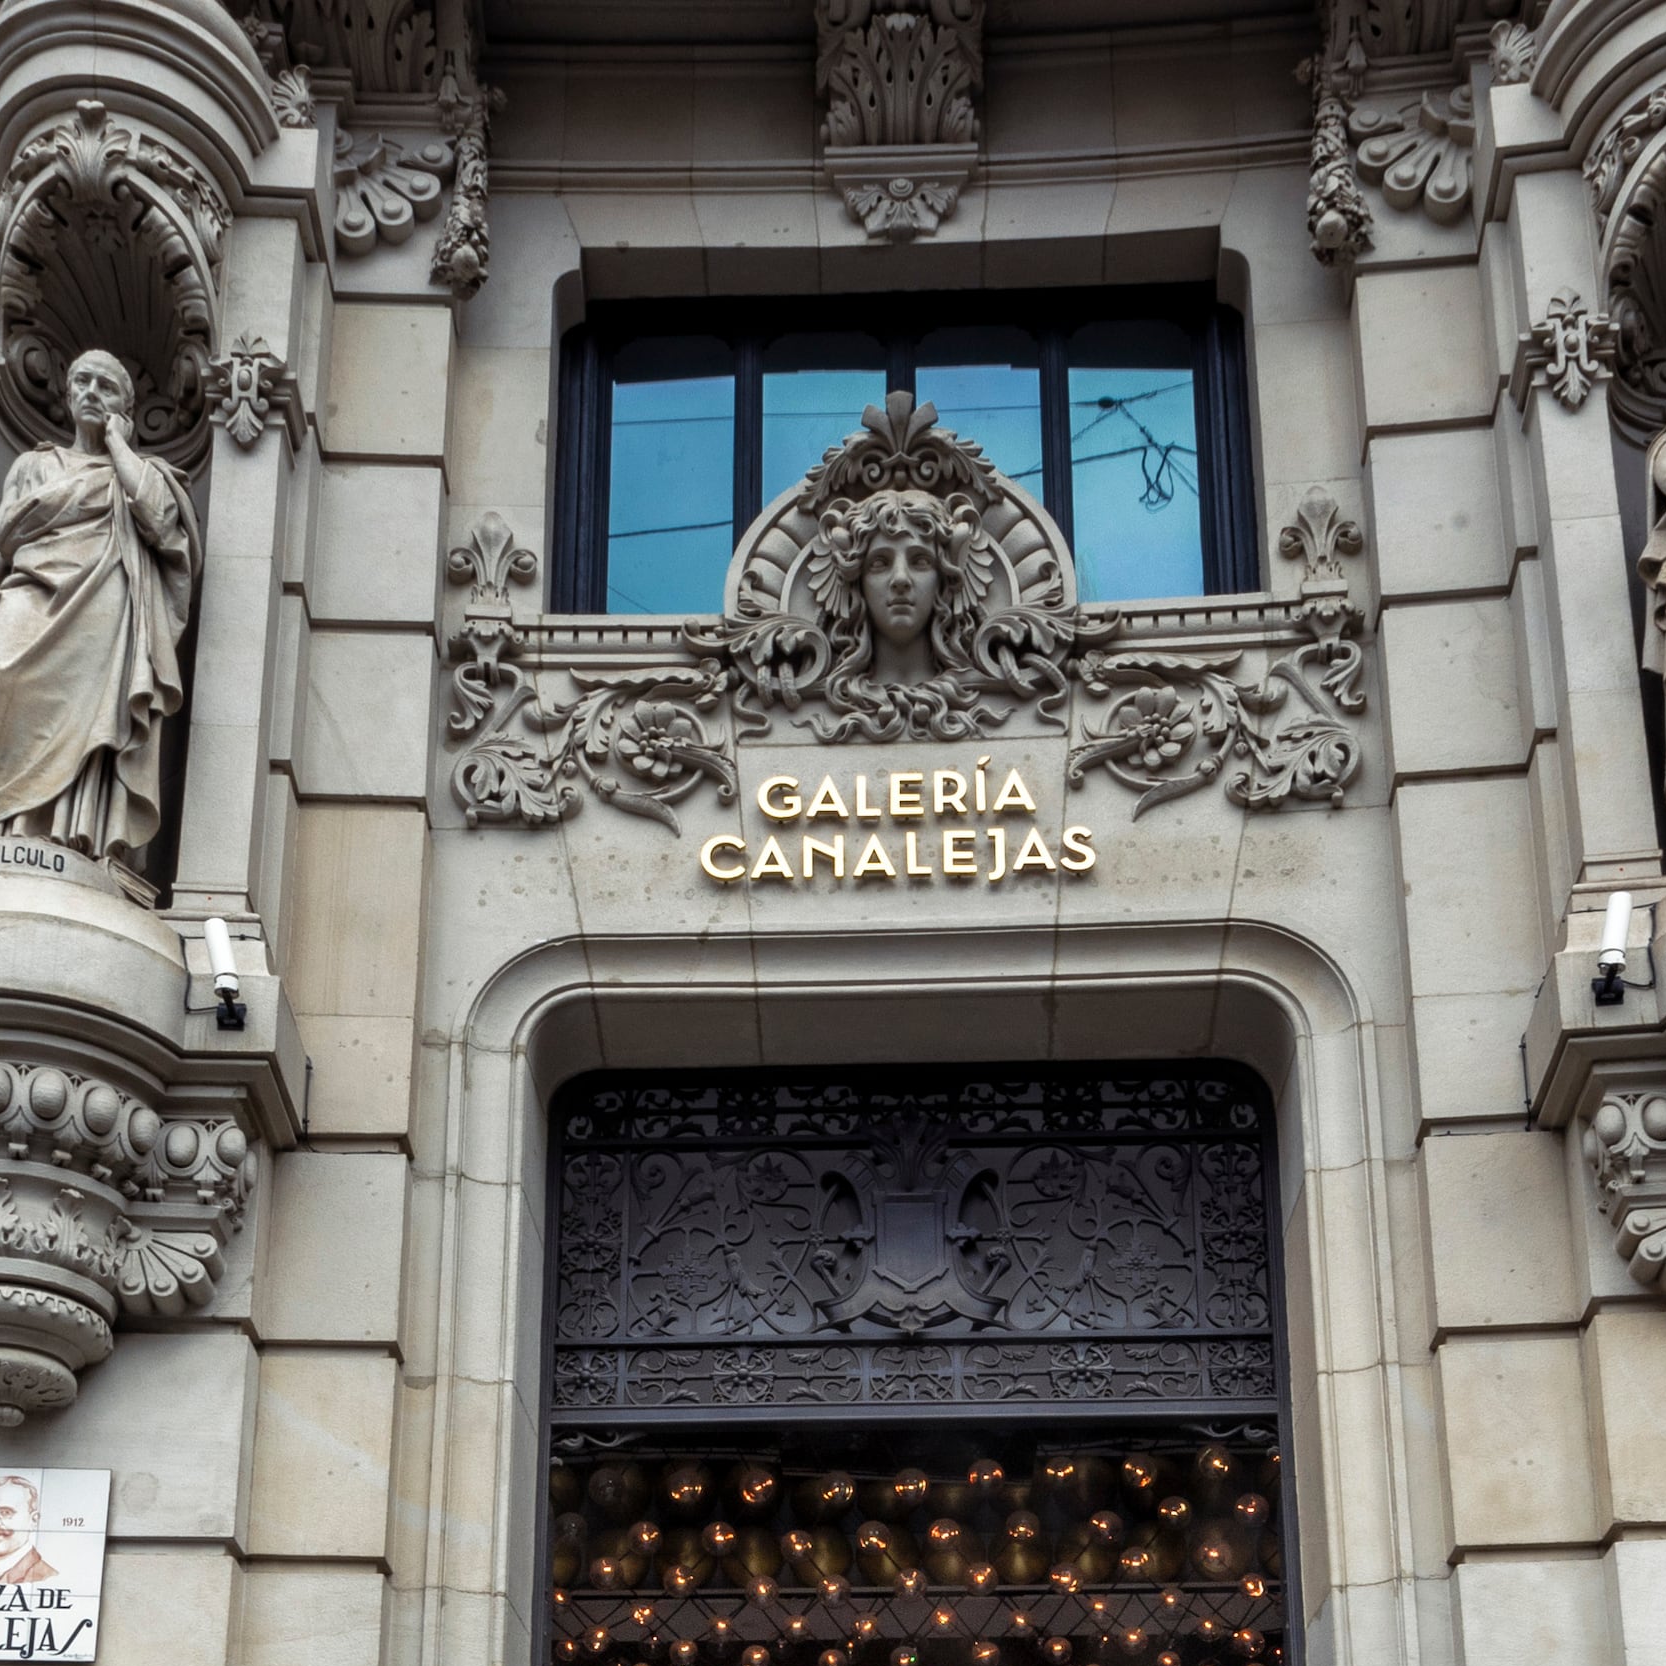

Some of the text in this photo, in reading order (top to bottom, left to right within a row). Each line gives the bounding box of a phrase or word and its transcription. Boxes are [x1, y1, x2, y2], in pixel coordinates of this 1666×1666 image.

[756, 755, 1037, 820] GALERÍA
[699, 825, 1097, 882] CANALEJAS
[62, 1517, 85, 1528] 1912
[36, 1588, 73, 1610] DE
